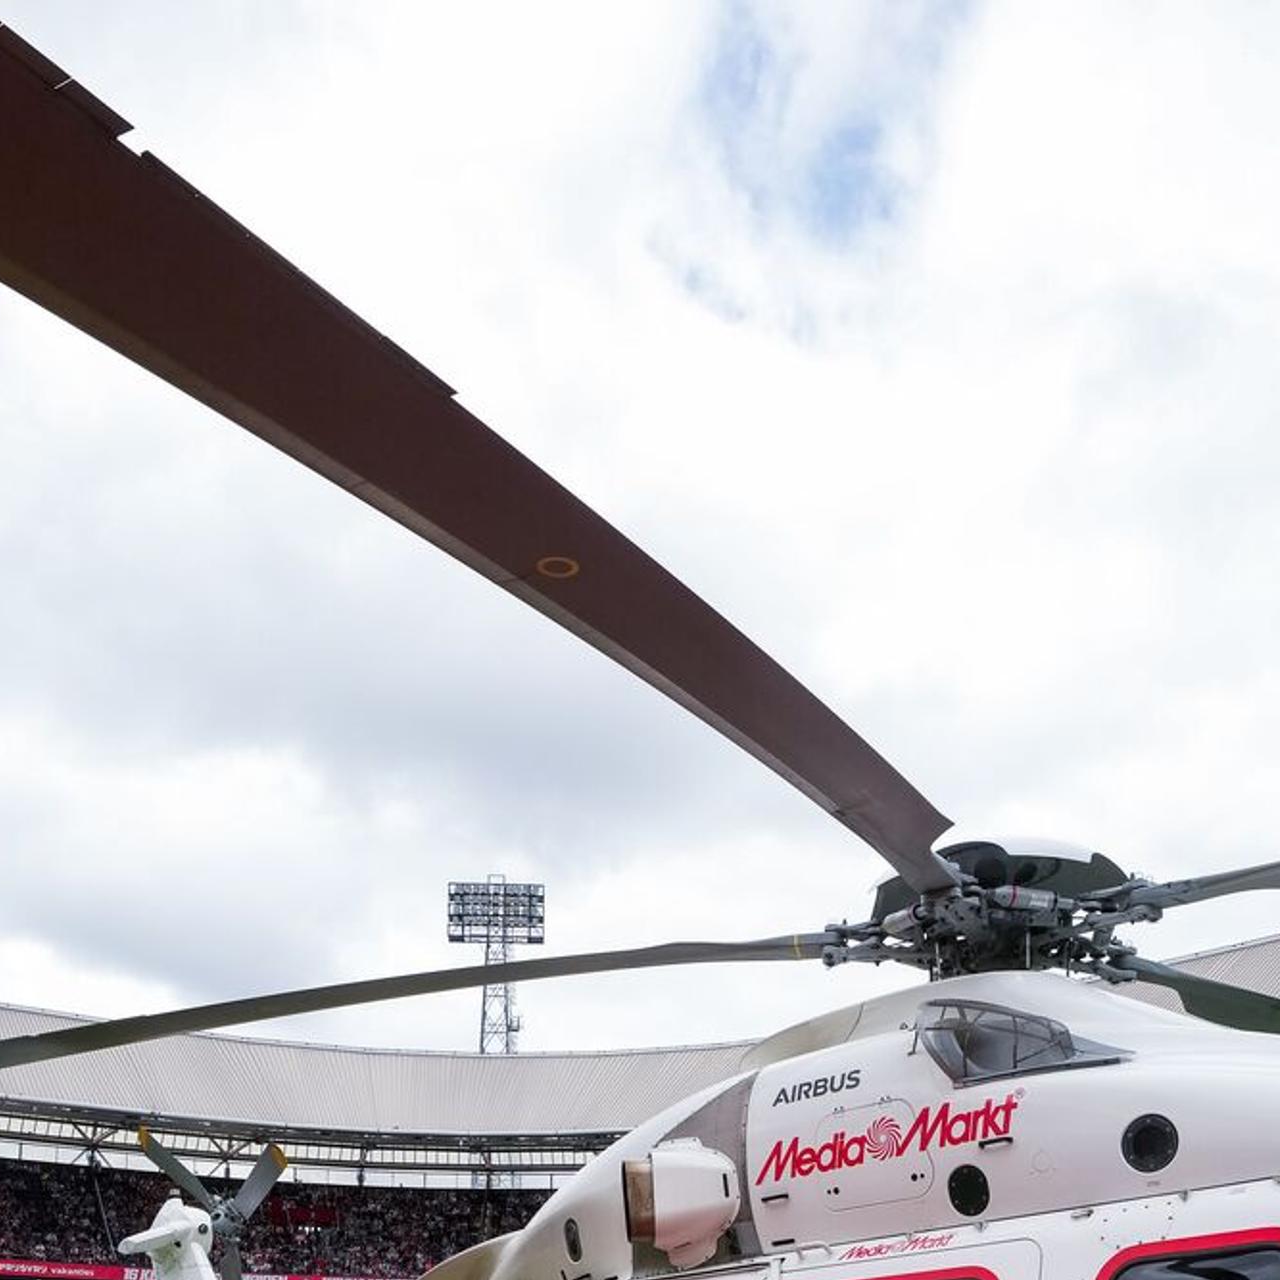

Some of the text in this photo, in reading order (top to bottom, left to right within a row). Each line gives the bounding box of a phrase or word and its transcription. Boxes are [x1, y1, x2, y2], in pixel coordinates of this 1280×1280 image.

[772, 1069, 861, 1107] AIRBUS
[756, 1095, 1019, 1186] Media Markt
